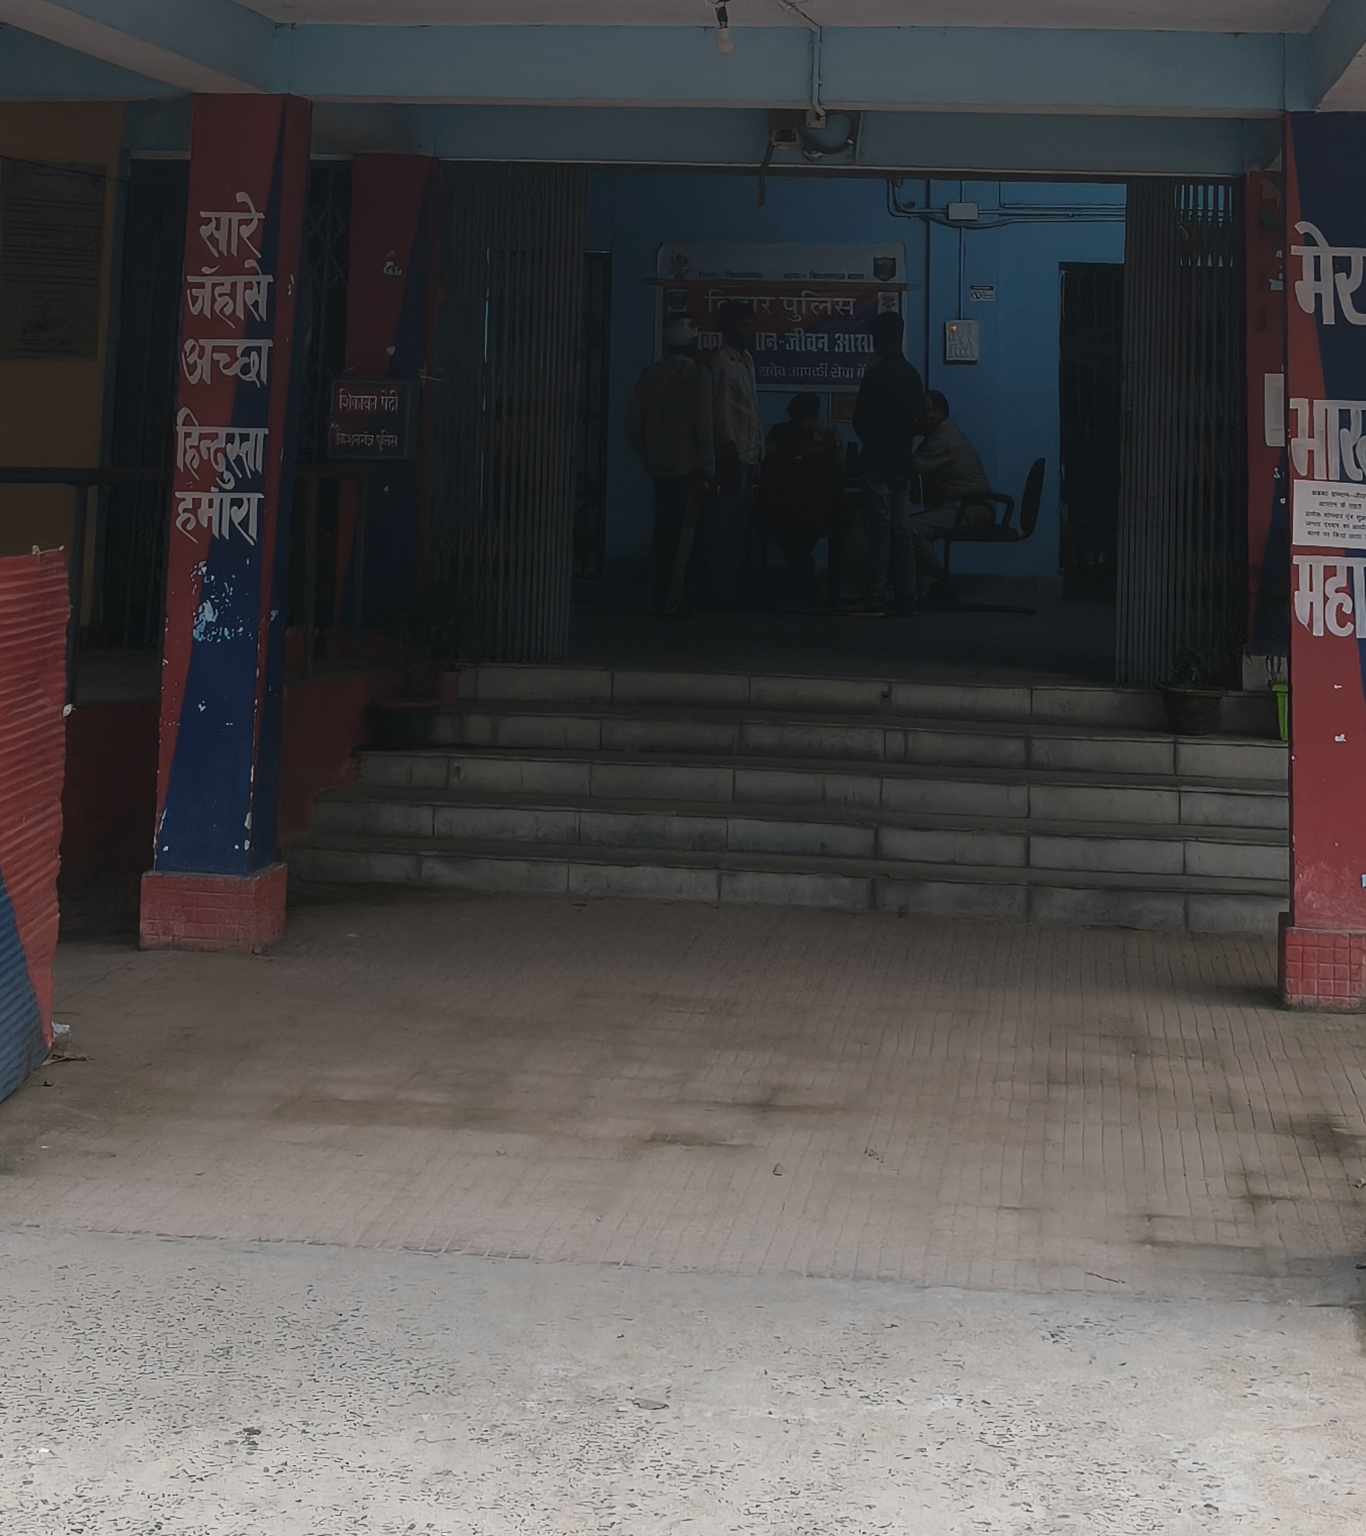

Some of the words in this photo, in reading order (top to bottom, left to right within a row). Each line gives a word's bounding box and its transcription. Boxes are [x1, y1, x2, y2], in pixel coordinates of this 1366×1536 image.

[199, 192, 265, 258] सारे
[779, 290, 857, 321] पुलिस
[181, 338, 273, 388] अच्छा
